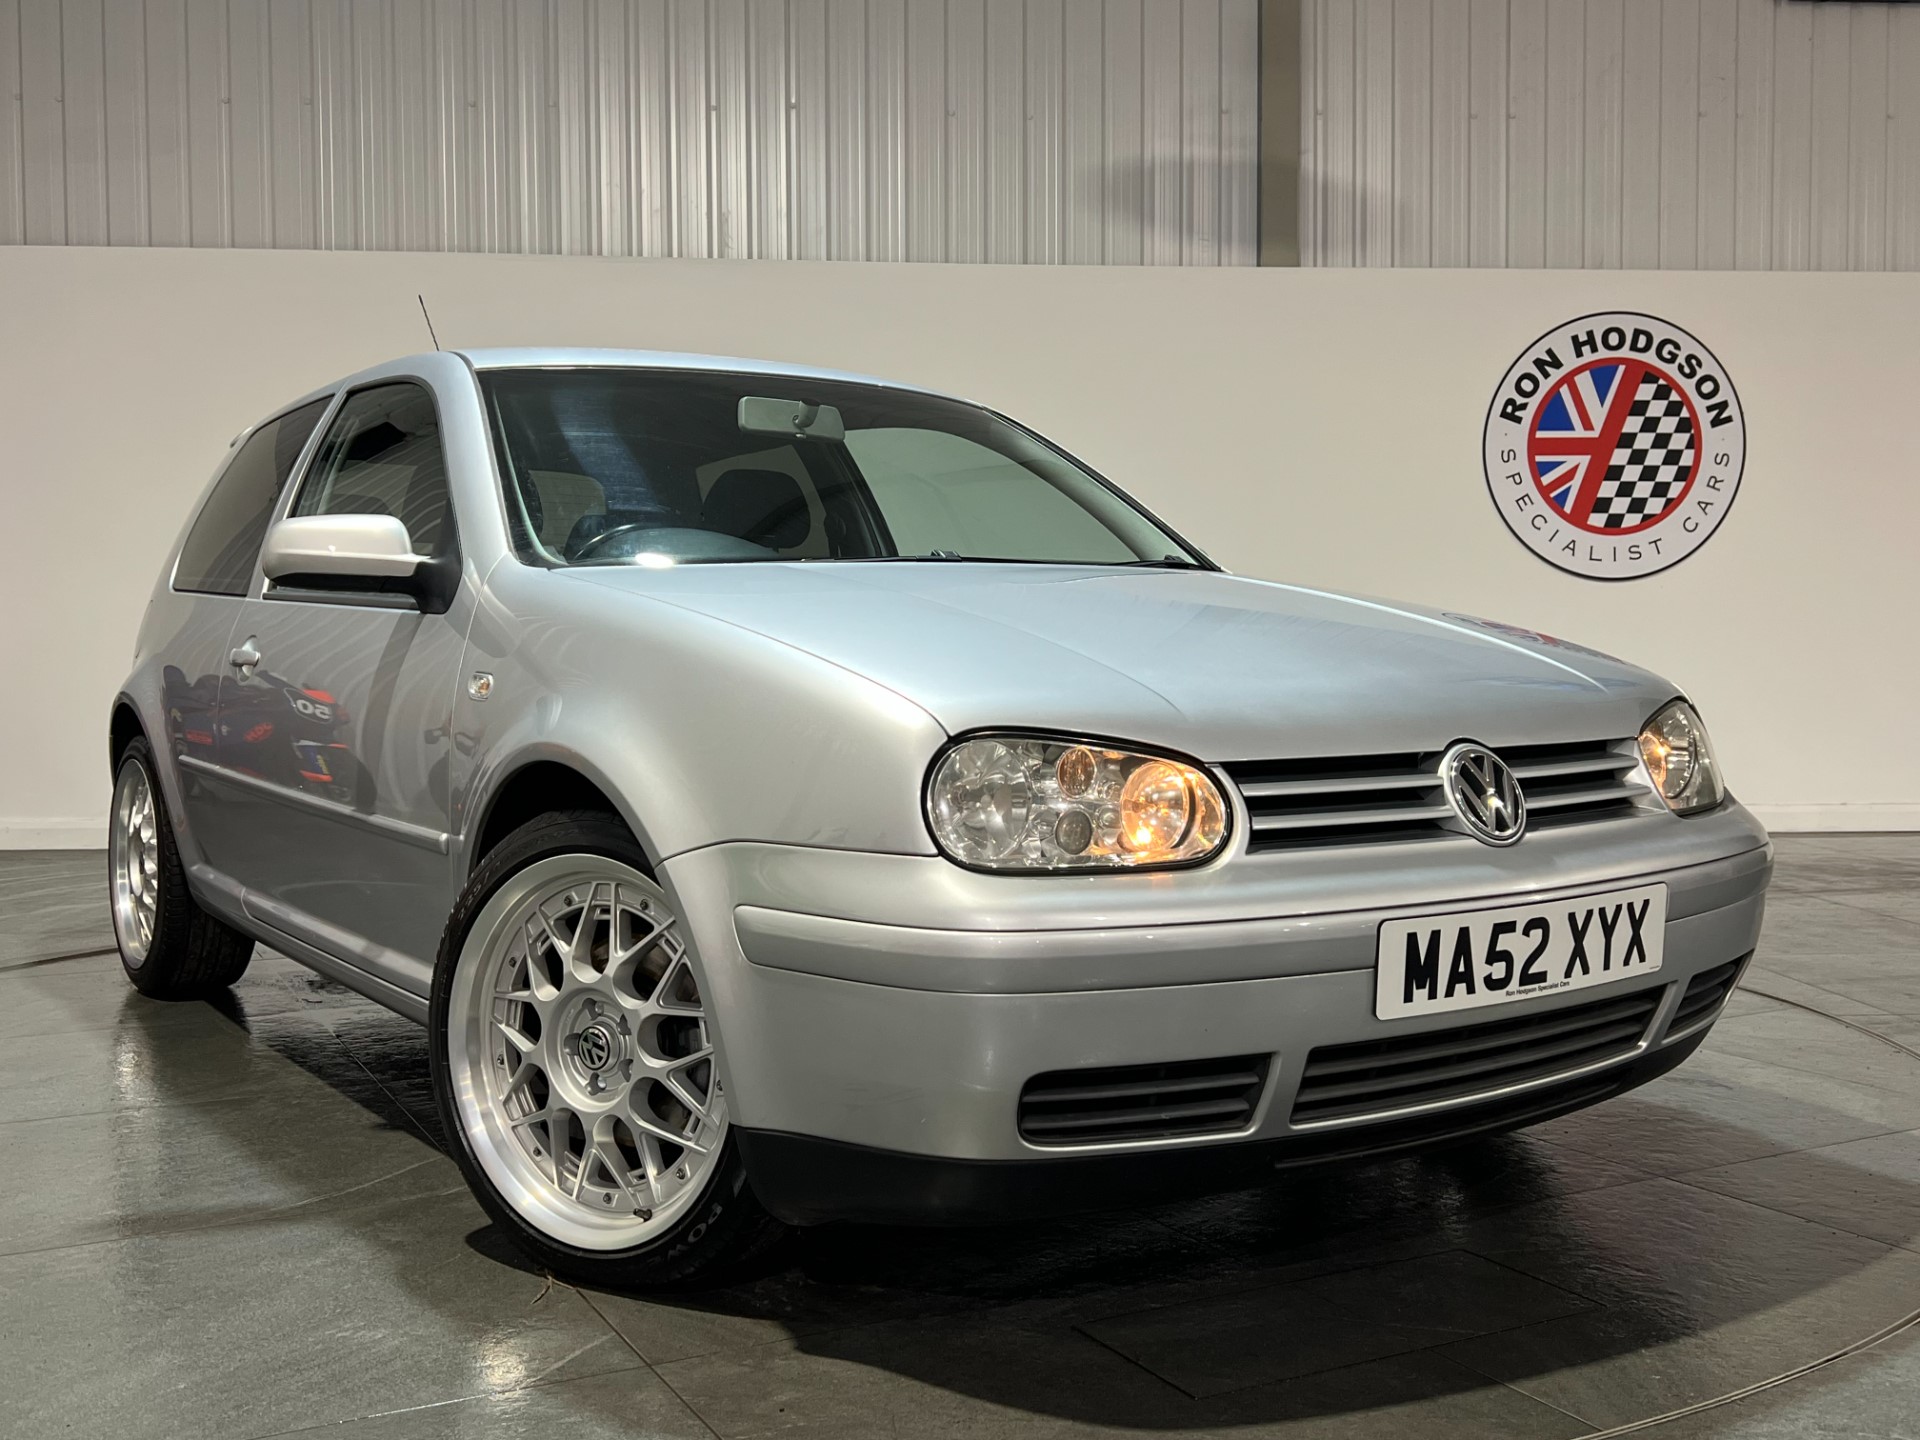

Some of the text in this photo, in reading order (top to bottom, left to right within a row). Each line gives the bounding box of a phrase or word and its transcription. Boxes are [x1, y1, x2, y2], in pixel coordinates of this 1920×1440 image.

[1499, 327, 1734, 429] RON HODGSON
[1501, 448, 1730, 562] SPECIALIST CARS
[1403, 899, 1650, 1004] MA52 XYX
[1516, 987, 1537, 995] Hodgson
[1537, 982, 1559, 992] Specialist
